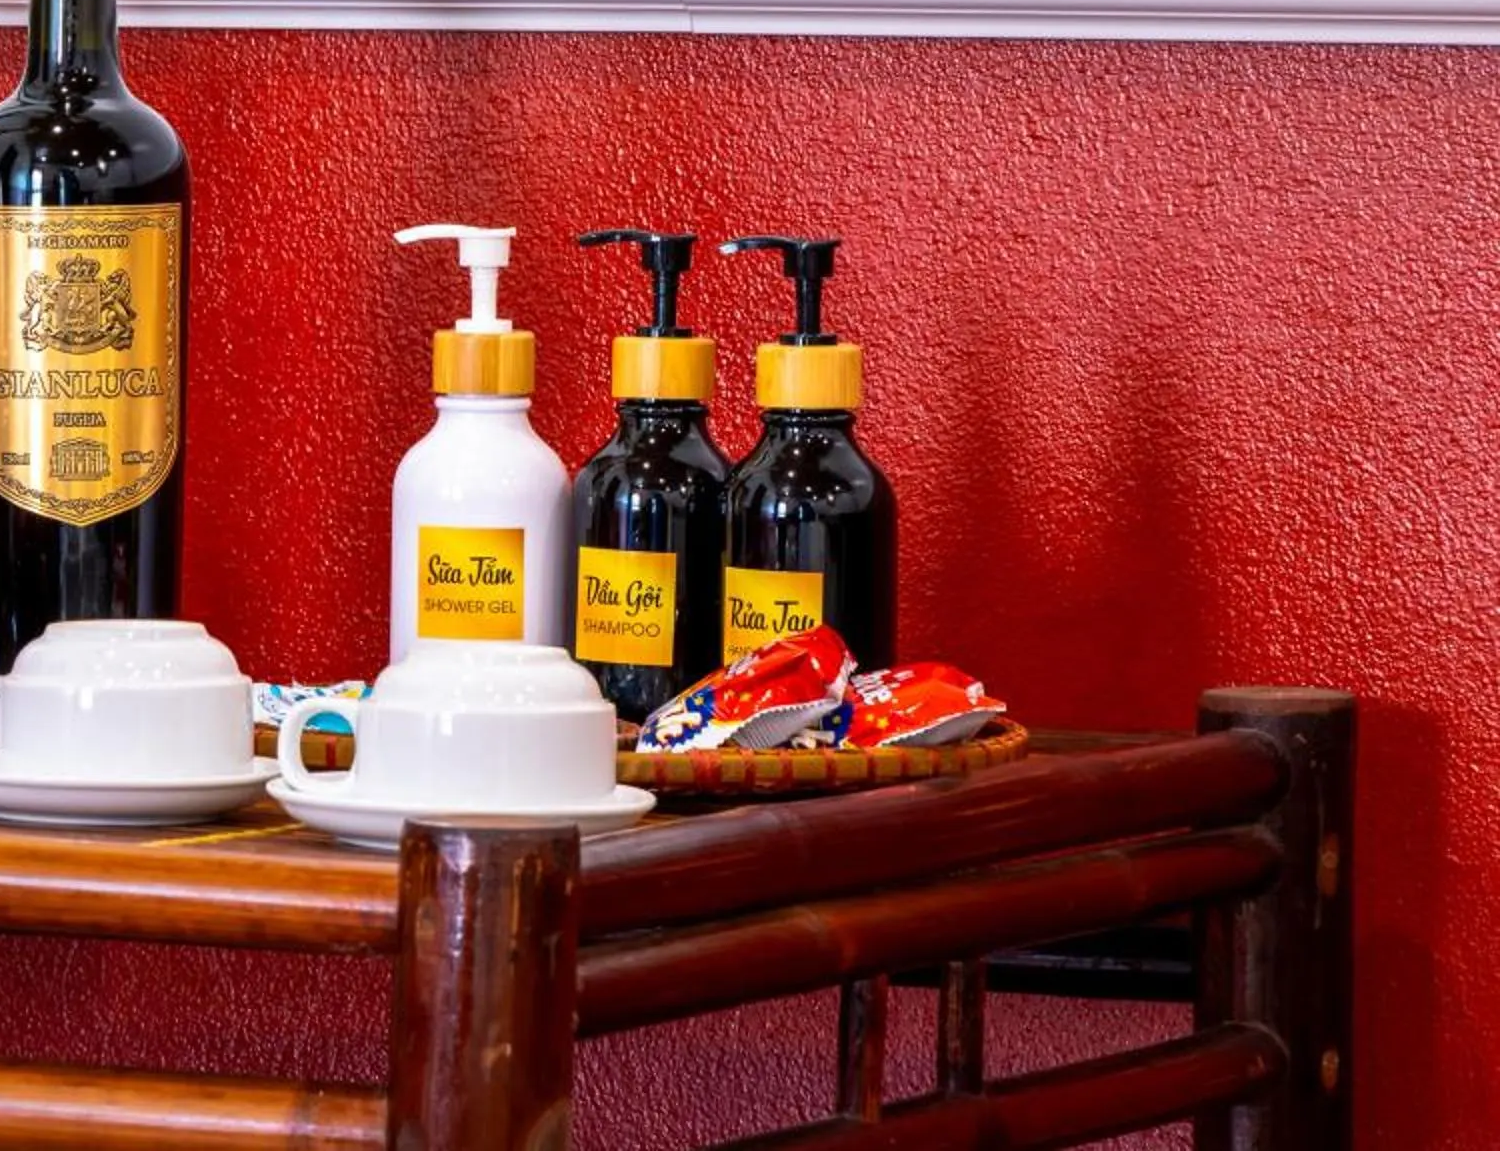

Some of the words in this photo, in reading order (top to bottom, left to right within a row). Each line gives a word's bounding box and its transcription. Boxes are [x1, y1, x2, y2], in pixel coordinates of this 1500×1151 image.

[424, 598, 485, 614] SHOWER
[488, 600, 517, 614] GEL
[583, 618, 661, 638] SHAMPOO
